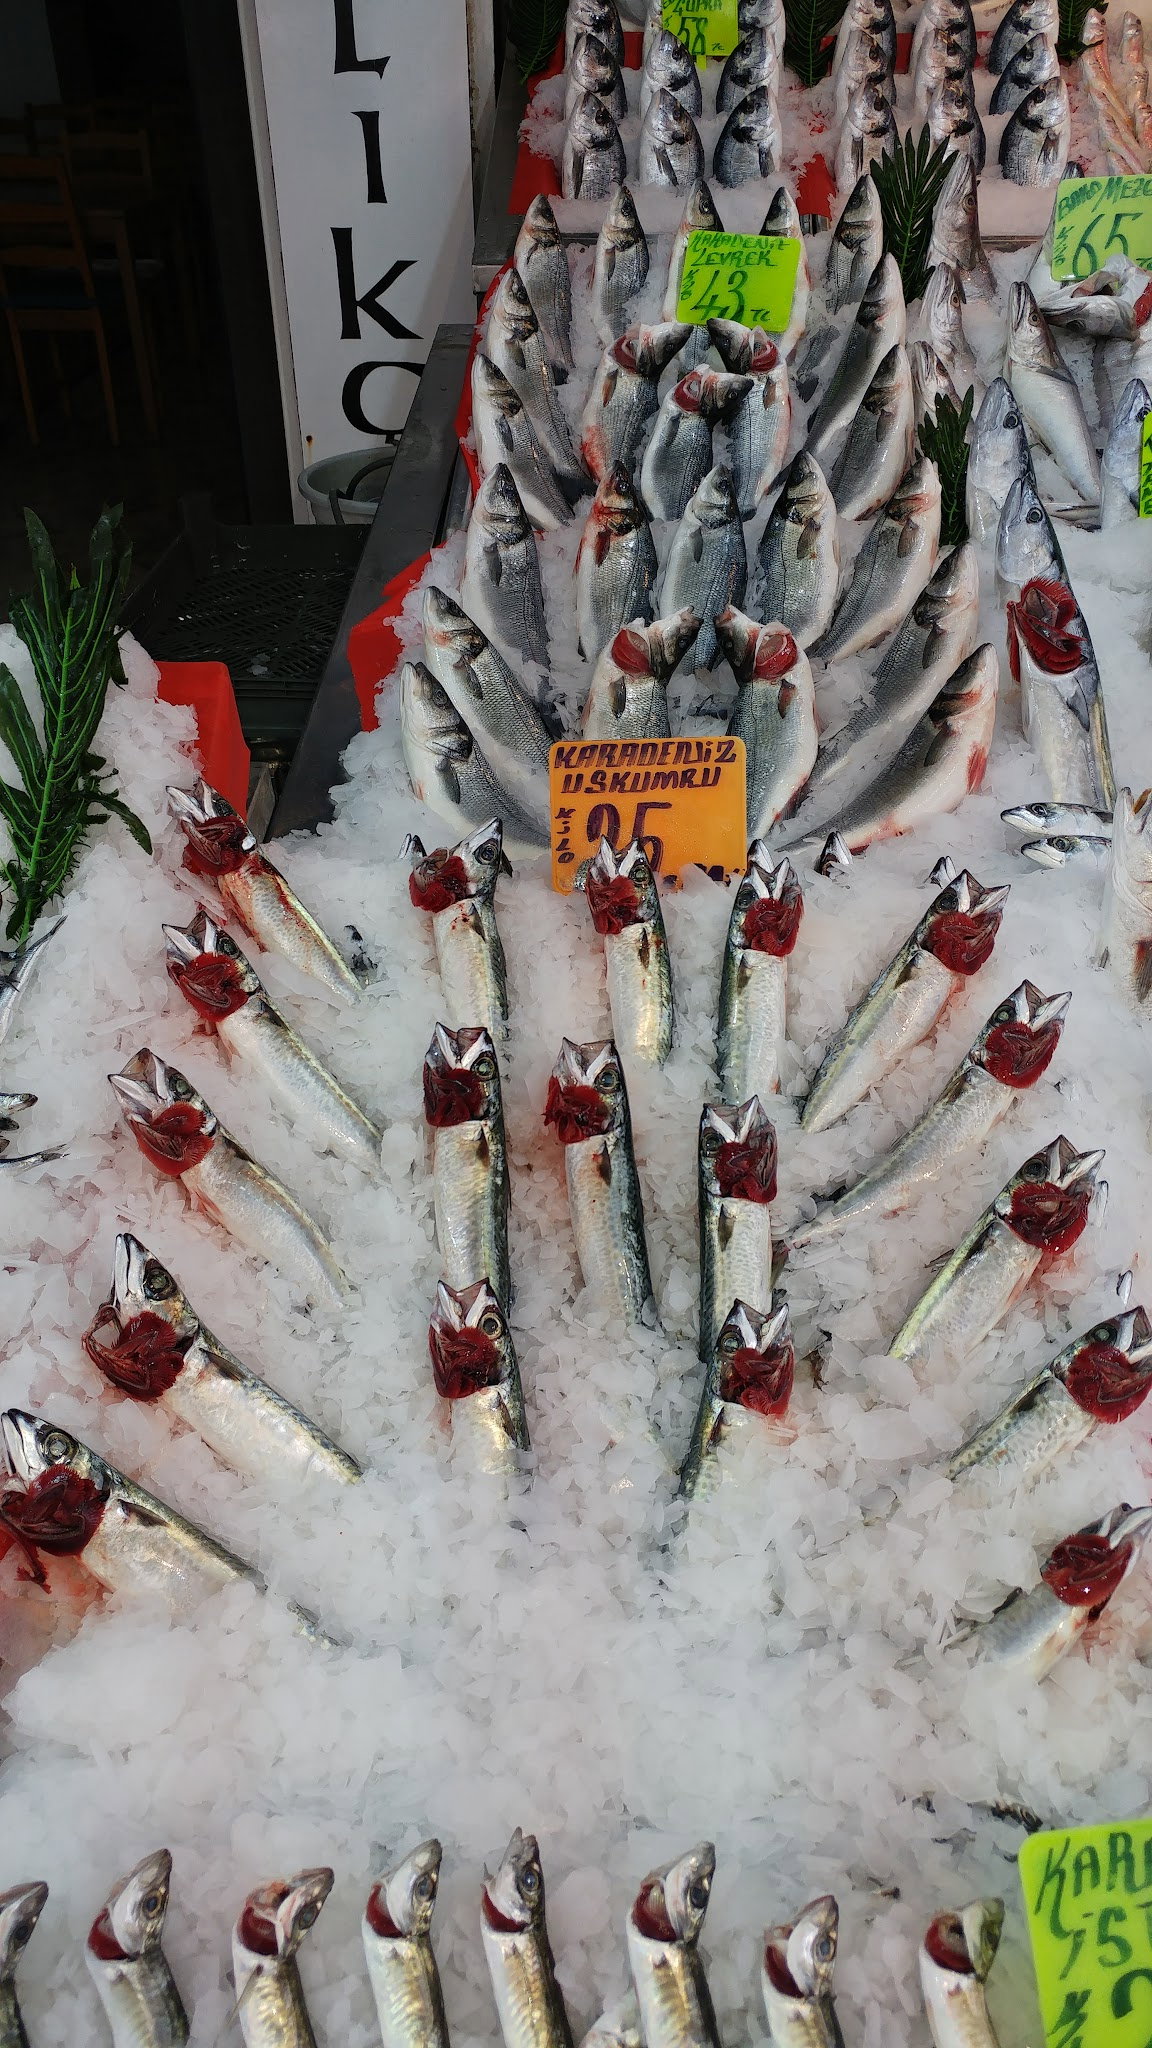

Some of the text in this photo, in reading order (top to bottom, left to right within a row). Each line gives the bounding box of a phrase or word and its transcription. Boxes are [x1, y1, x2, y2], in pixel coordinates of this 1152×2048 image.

[691, 247, 778, 267] LEVREK
[1073, 213, 1143, 279] 65
[561, 766, 722, 793] USKUMRU
